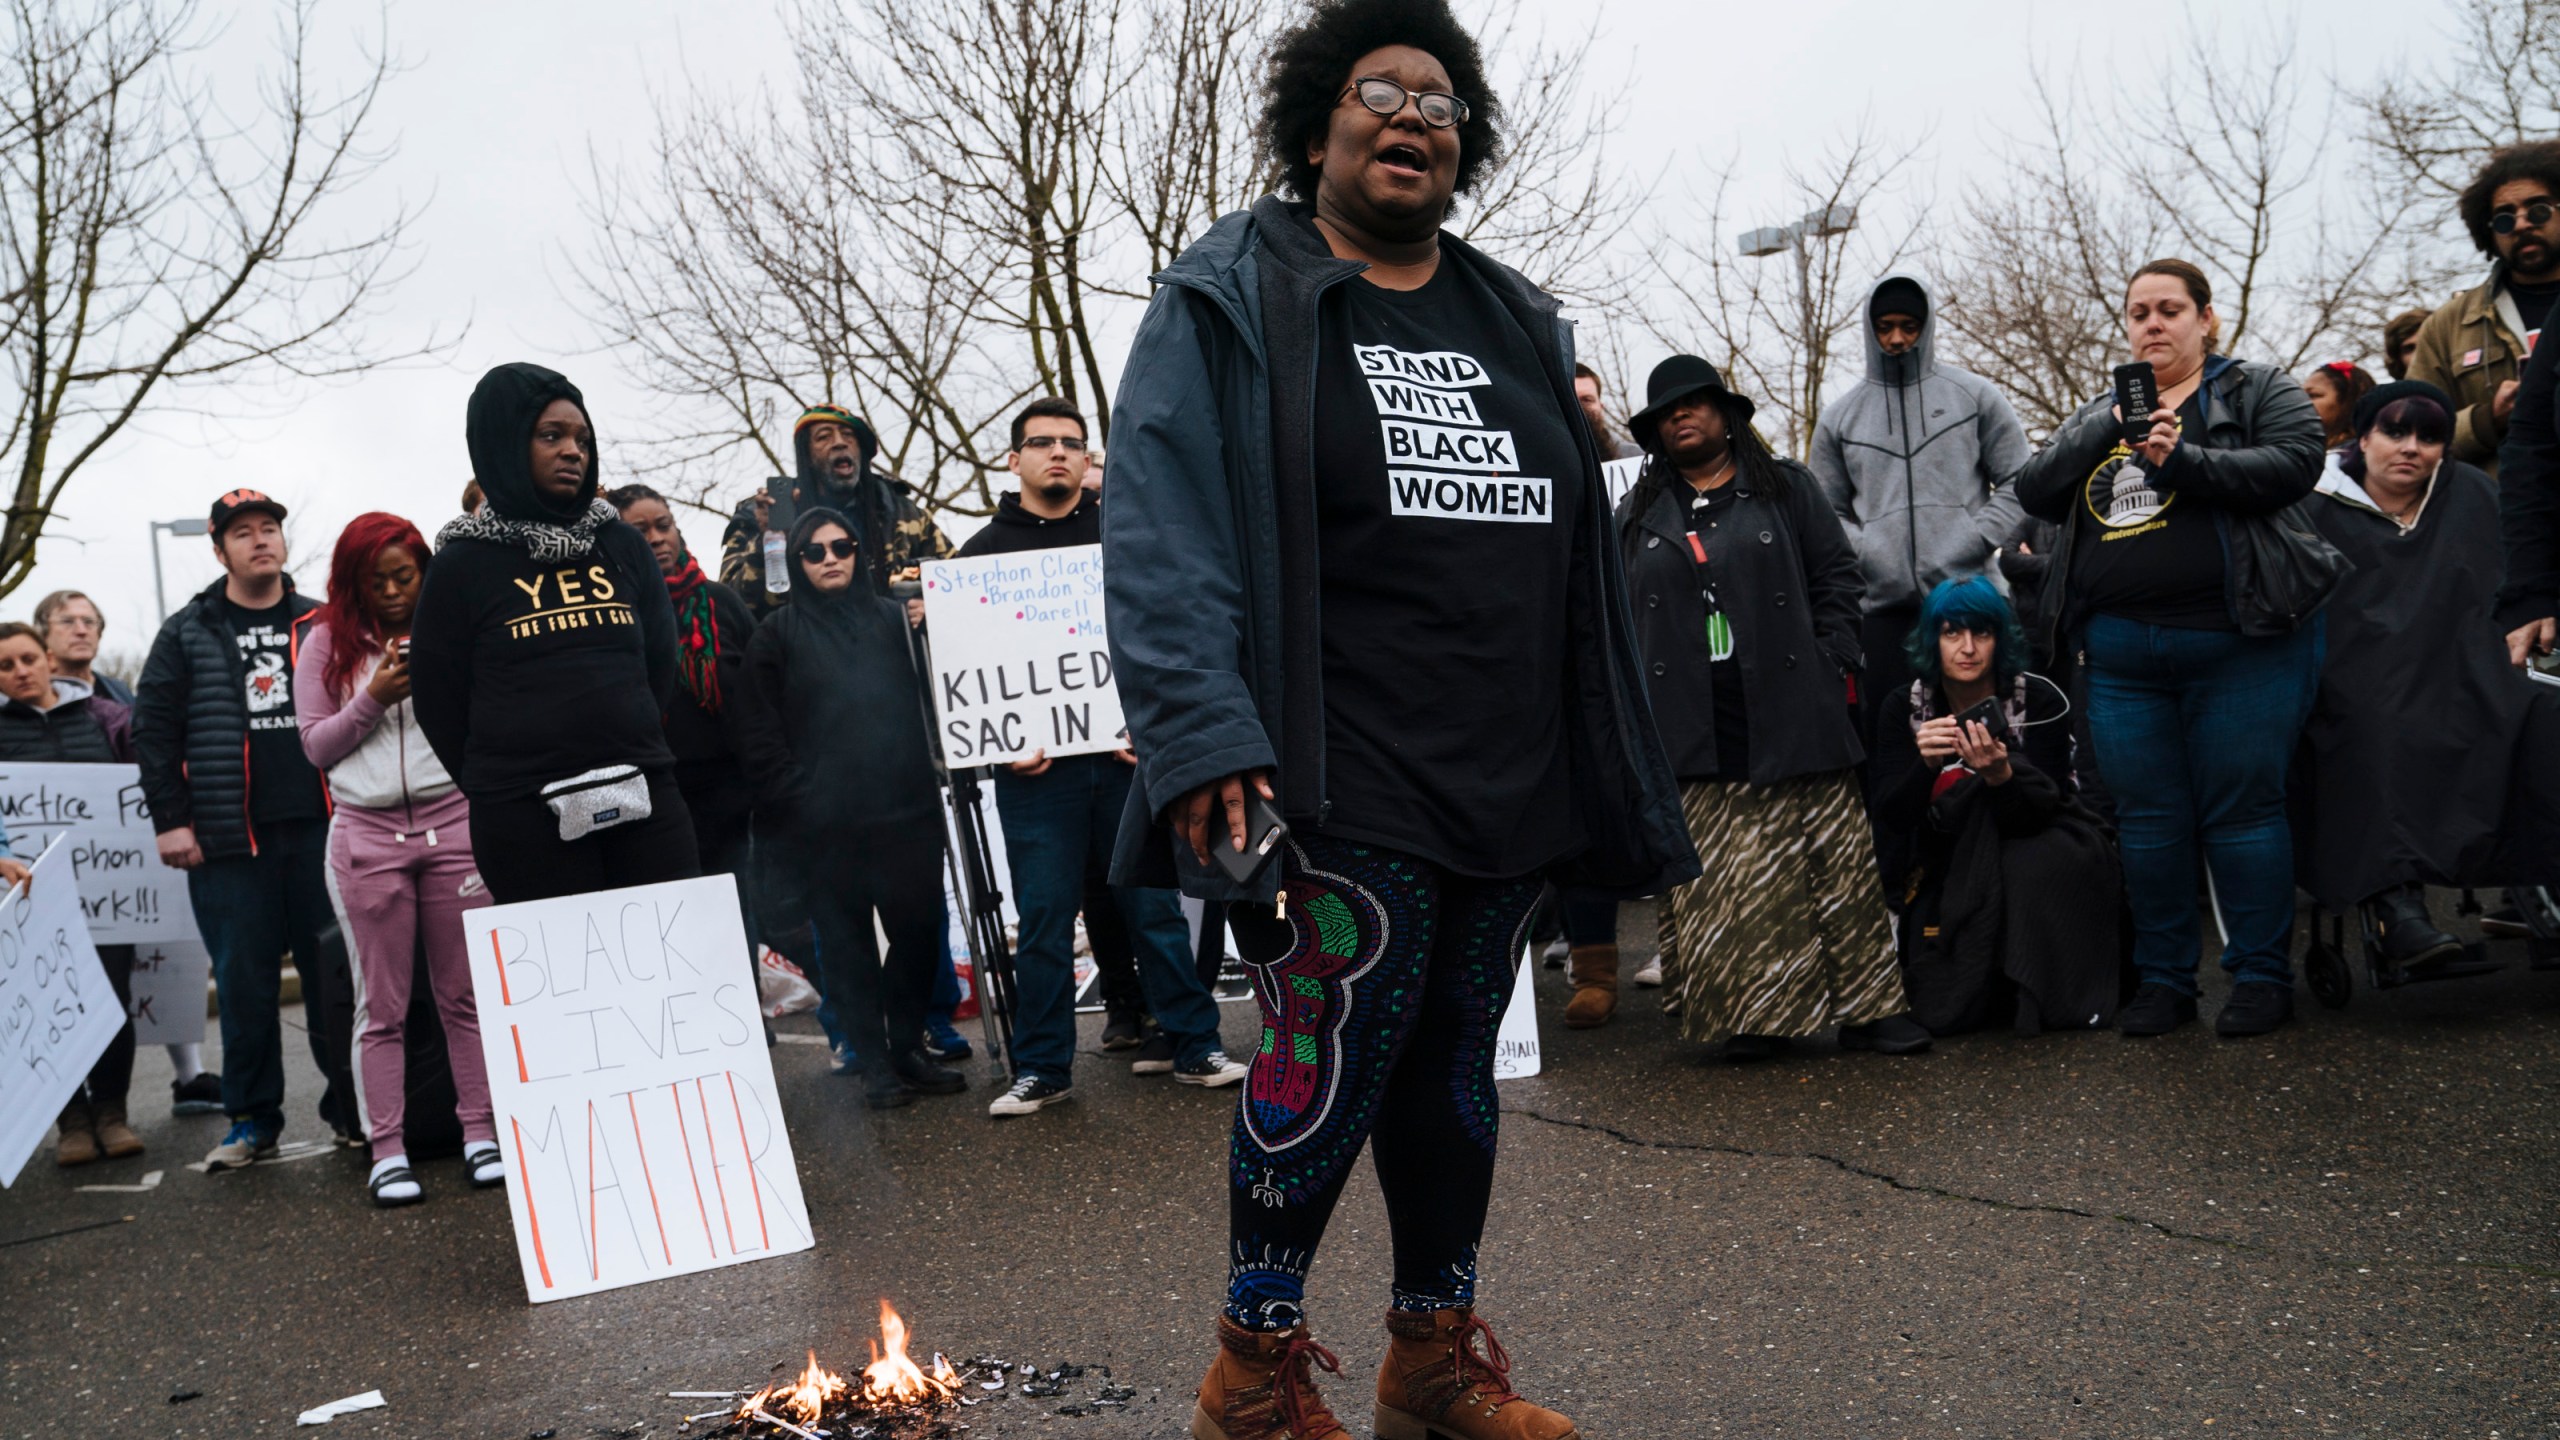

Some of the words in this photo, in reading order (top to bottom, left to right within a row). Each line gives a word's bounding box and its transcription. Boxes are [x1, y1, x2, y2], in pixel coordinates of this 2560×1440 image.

[1359, 349, 1480, 383] STAND
[1375, 383, 1474, 421] WITH
[1387, 426, 1512, 465] BLACK
[1394, 477, 1547, 516] WOMEN
[514, 565, 615, 609] YES
[934, 559, 1032, 593] Stephon
[989, 579, 1071, 606] Brandon
[511, 619, 540, 639] THE
[548, 611, 589, 632] FUCK
[595, 610, 603, 625] I
[1025, 599, 1088, 622] Darell
[1078, 619, 1104, 637] Ma
[943, 651, 1112, 713] KILLED
[947, 712, 1026, 759] SAC
[1051, 703, 1090, 747] IN
[0, 777, 94, 822] uctice
[117, 785, 151, 827] Fo
[486, 900, 702, 1006] BLACK
[511, 984, 750, 1083] LIVES
[1496, 1040, 1538, 1059] SHALL
[1494, 1059, 1517, 1075] ES
[511, 1071, 809, 1289] MATTER
